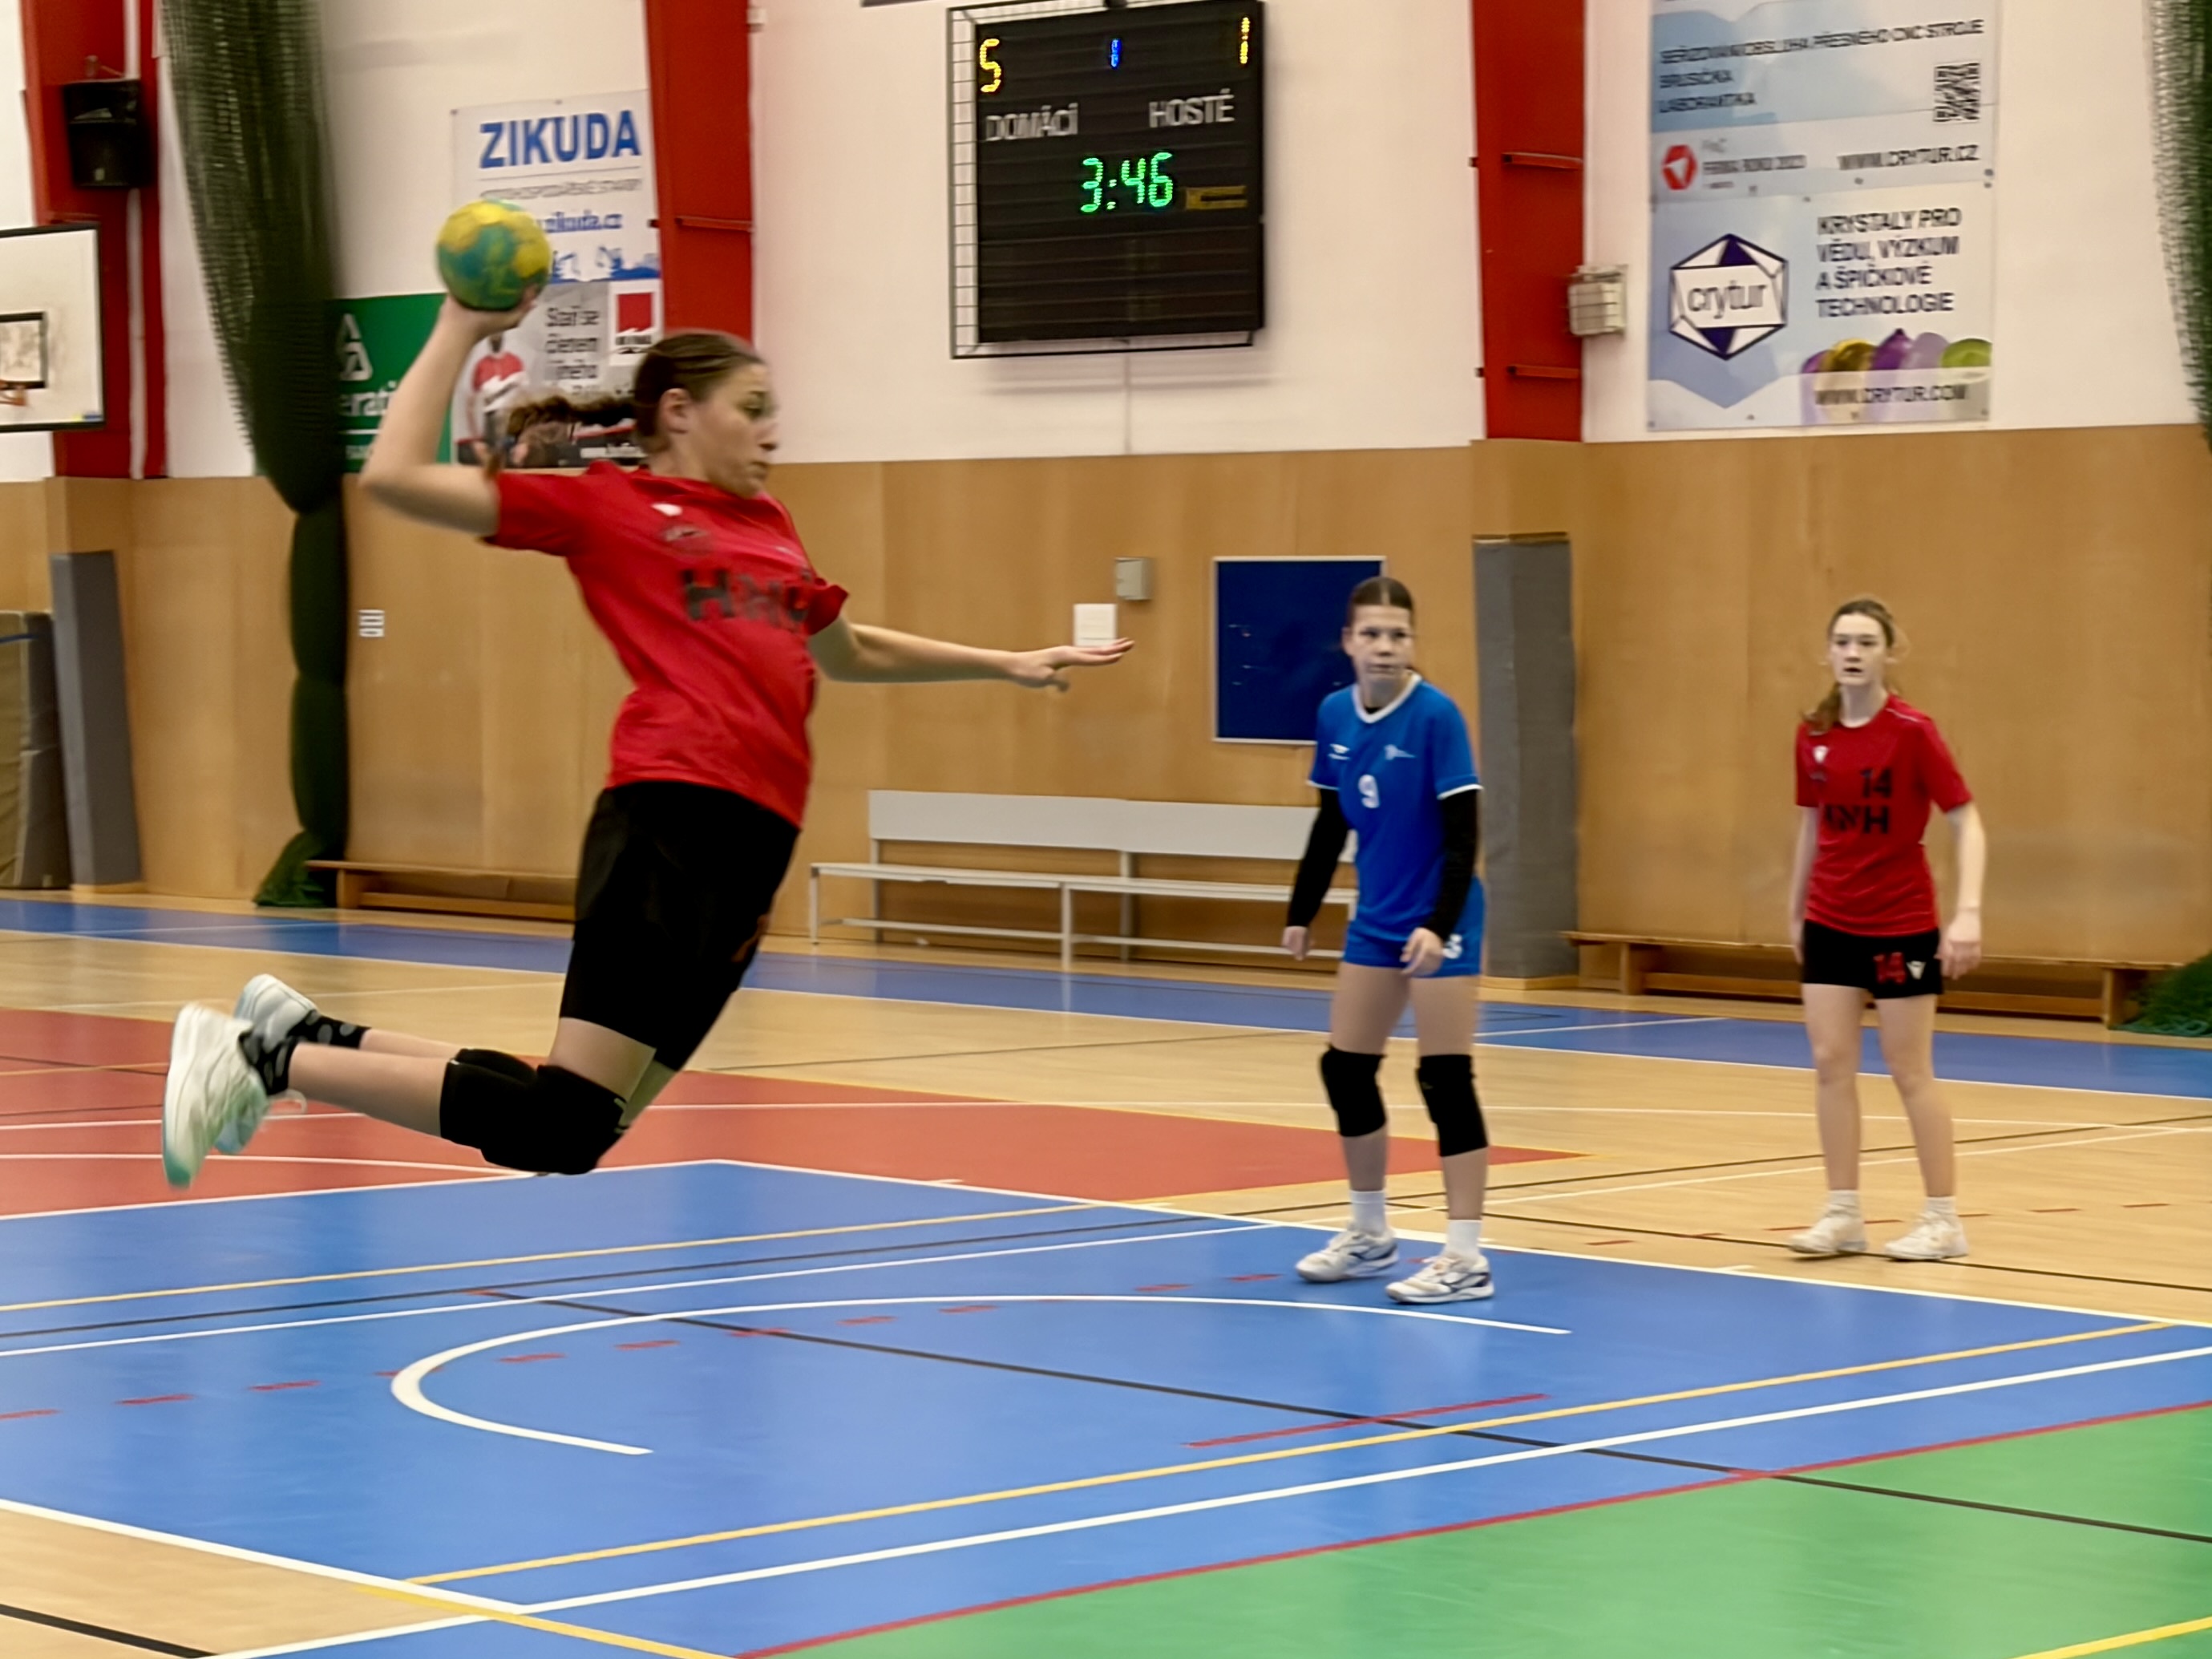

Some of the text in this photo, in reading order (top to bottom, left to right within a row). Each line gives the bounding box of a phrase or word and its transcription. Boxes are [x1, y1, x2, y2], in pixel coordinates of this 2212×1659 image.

[1110, 38, 1122, 69] 1
[1239, 17, 1251, 64] 1
[985, 87, 1235, 141] DOMÁCÍ HOSTÉ
[479, 110, 641, 169] ZIKUDA
[1080, 152, 1174, 212] 3:46
[1817, 207, 1962, 235] KRYSTALY PRO
[1877, 234, 1959, 258] VÝZKUM
[1815, 261, 1933, 290] A ŠPIČKOVÉ
[1688, 280, 1767, 319] crytur
[1815, 292, 1955, 318] TECHNOLOGIE
[1358, 775, 1380, 808] 9
[1860, 767, 1892, 798] 14
